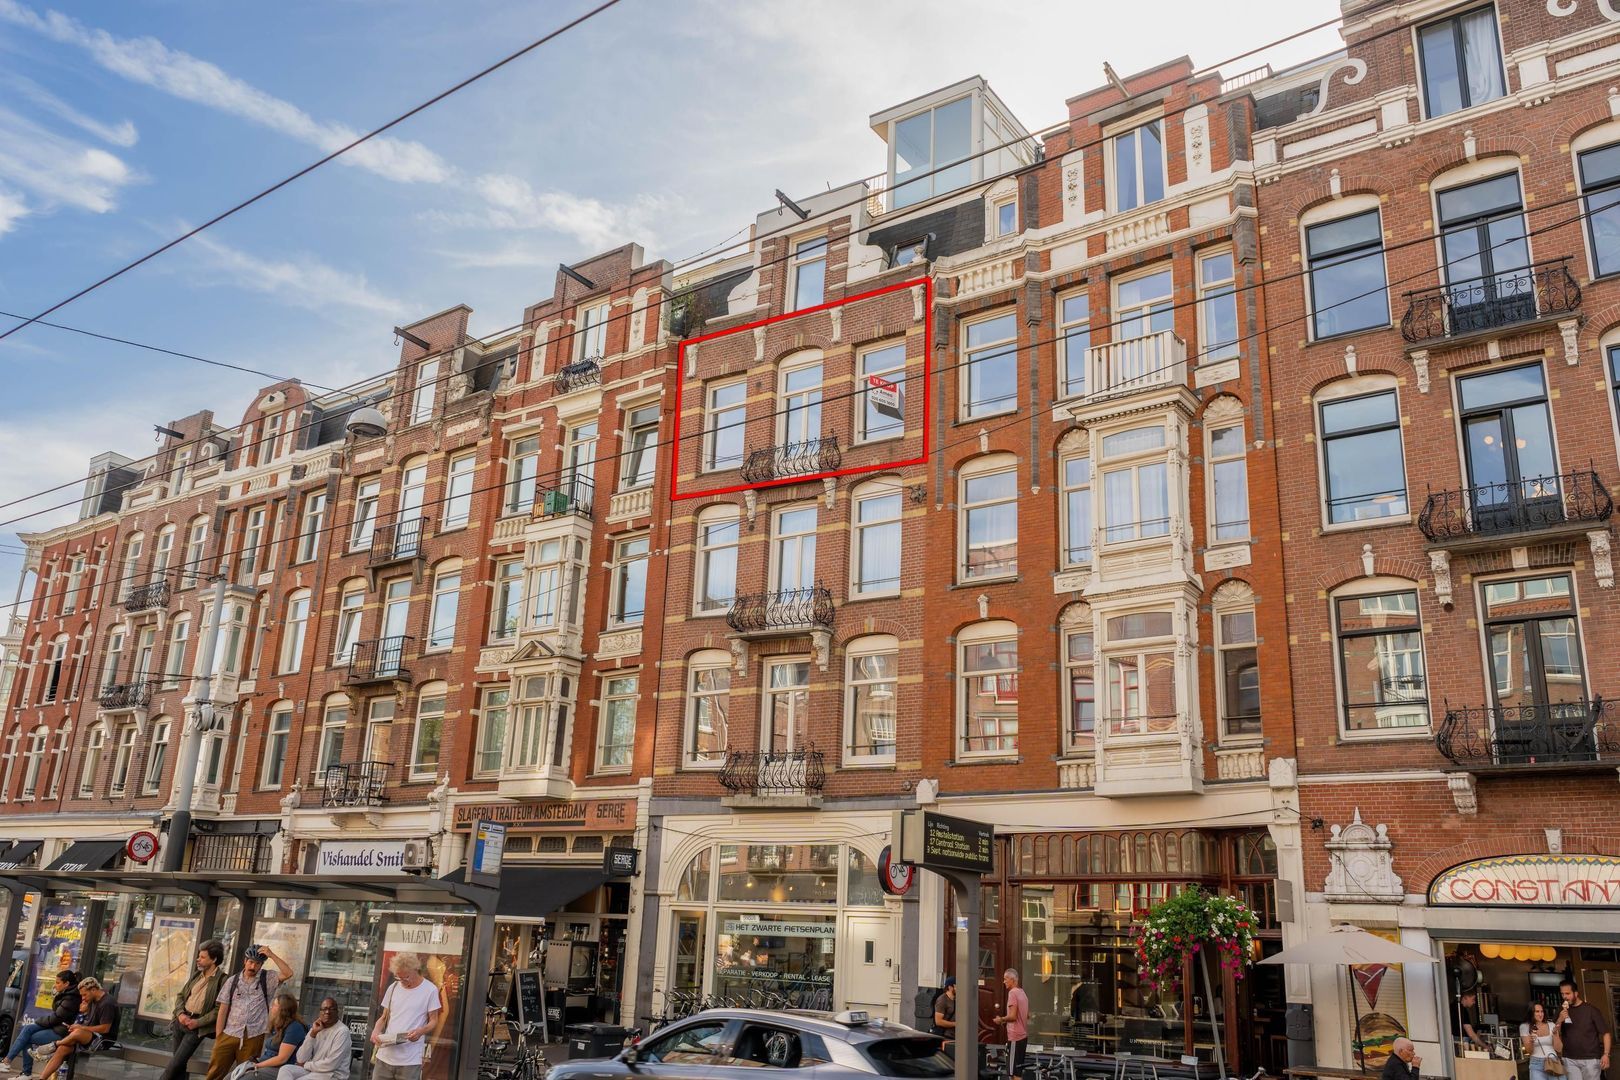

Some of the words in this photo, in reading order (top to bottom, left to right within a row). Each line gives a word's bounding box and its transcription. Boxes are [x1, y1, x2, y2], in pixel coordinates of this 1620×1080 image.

[458, 807, 494, 822] SLAGERIJ
[495, 805, 533, 820] TRAITEUR
[534, 802, 587, 819] AMSTERDAM
[597, 803, 625, 819] SERGE
[955, 841, 971, 851] Station
[322, 849, 374, 867] Vishandel
[614, 854, 633, 866] SERGE
[735, 923, 749, 931] HET
[751, 924, 782, 933] ZWARTE
[784, 925, 835, 934] FIETSENPLAN
[402, 929, 448, 946] VALENTO
[719, 968, 746, 976] EPARATIE
[752, 970, 779, 978] VERKOOP
[784, 972, 806, 980] RENTAL
